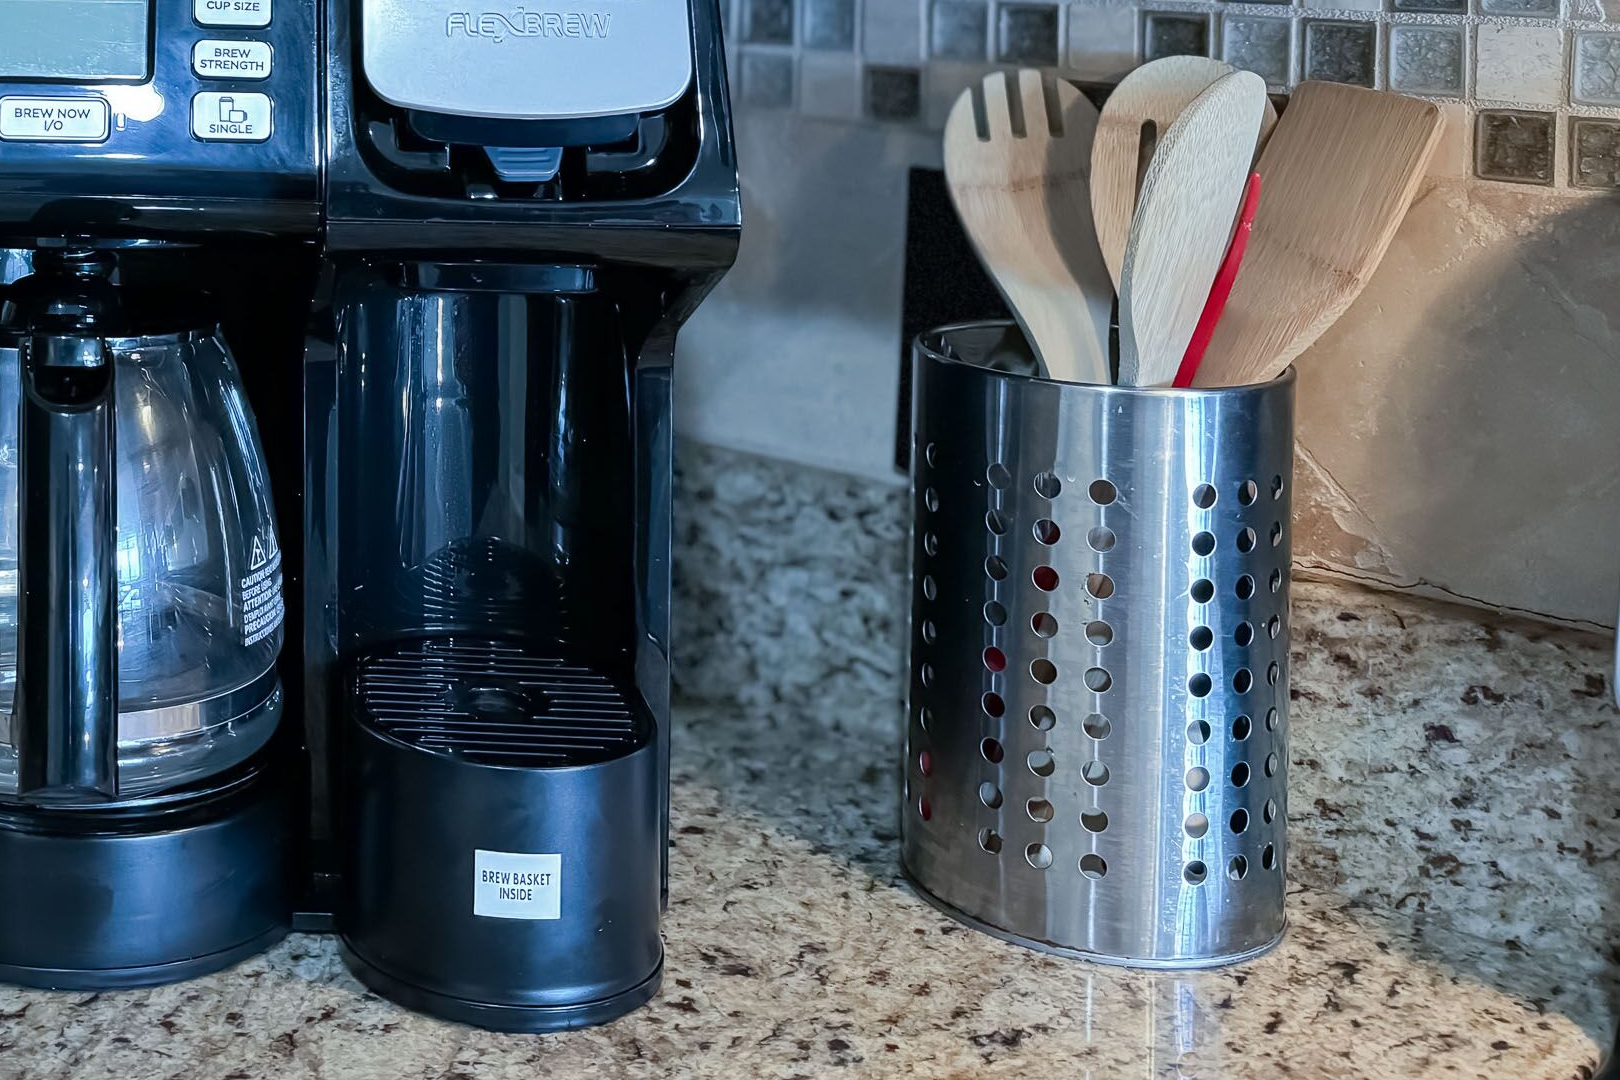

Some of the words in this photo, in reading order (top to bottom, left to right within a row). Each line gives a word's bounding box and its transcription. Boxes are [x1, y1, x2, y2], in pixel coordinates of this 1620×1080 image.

[206, 0, 231, 10] CUP
[233, 1, 260, 12] SIZE
[445, 6, 612, 44] FLEXBREW
[214, 47, 251, 59] BREW
[199, 59, 264, 71] STRENGTH
[14, 107, 54, 118] BREW
[57, 108, 91, 119] NOW
[44, 119, 64, 132] I/O
[209, 123, 253, 134] SINGLE
[482, 870, 511, 885] BREW
[513, 873, 551, 886] BASKET
[499, 887, 533, 901] INSIDE
